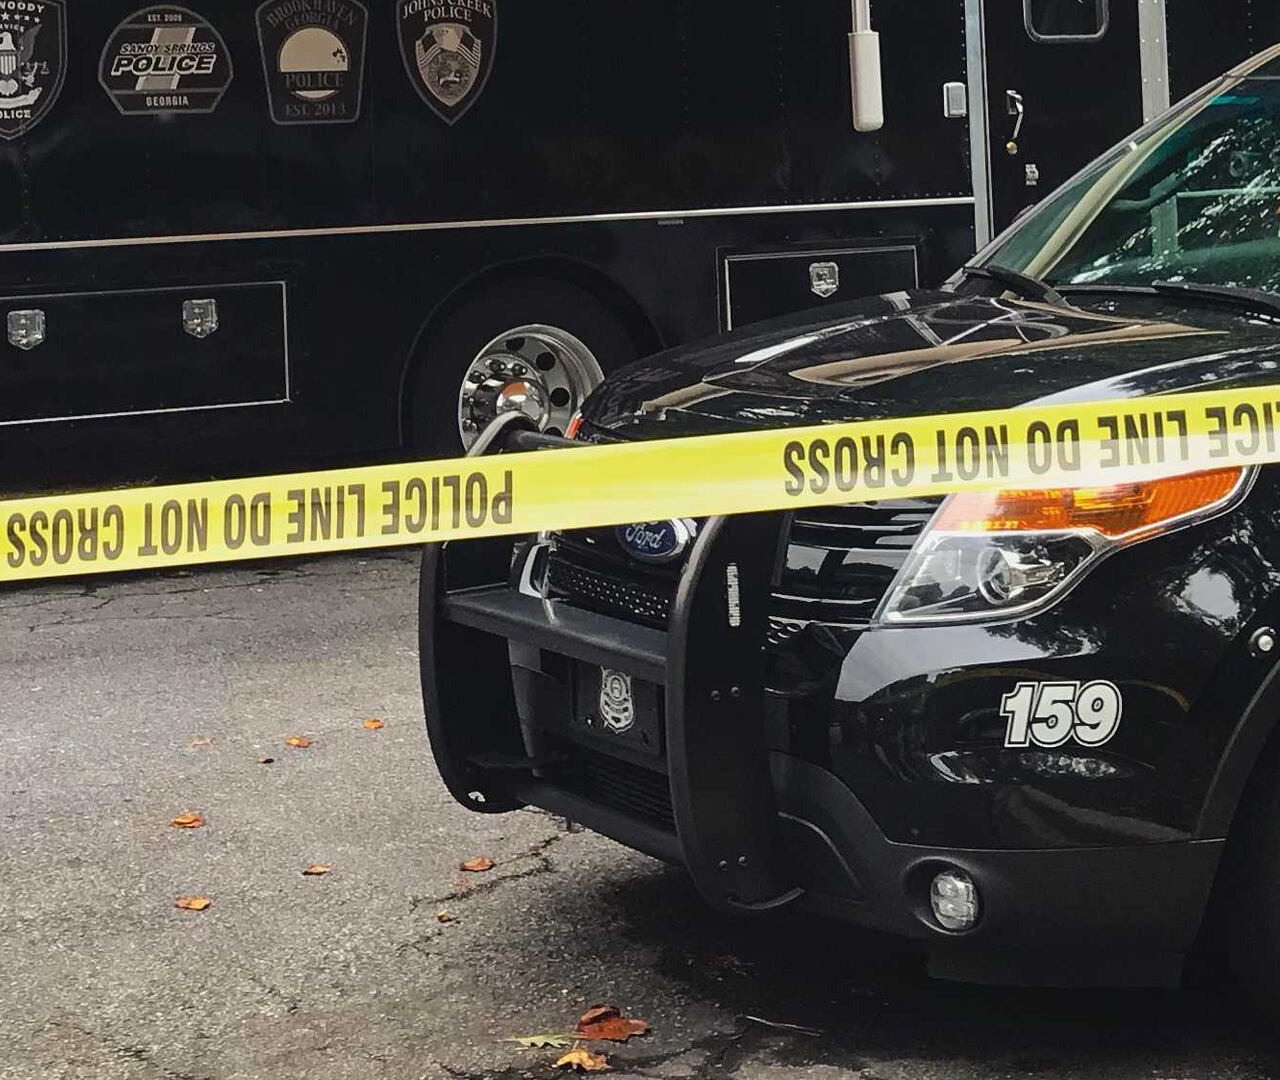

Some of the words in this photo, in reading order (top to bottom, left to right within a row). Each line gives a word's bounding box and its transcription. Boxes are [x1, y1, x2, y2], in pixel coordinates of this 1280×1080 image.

[424, 6, 472, 22] POLICE
[111, 54, 217, 76] POLICE
[121, 43, 160, 54] SANDY
[163, 42, 216, 54] SPRINGS
[146, 96, 189, 107] GEORGIA
[285, 72, 345, 88] POLICE
[783, 432, 915, 497] CROSS
[930, 425, 1010, 484] NOT
[1025, 418, 1082, 474] DO
[1097, 409, 1189, 469] LINE
[138, 497, 209, 557] NOT
[223, 491, 272, 550] DO
[286, 483, 366, 544] LINE
[381, 470, 514, 535] POLICE
[6, 504, 124, 569] CROSS
[625, 520, 666, 549] Ford
[999, 679, 1123, 748] 159
